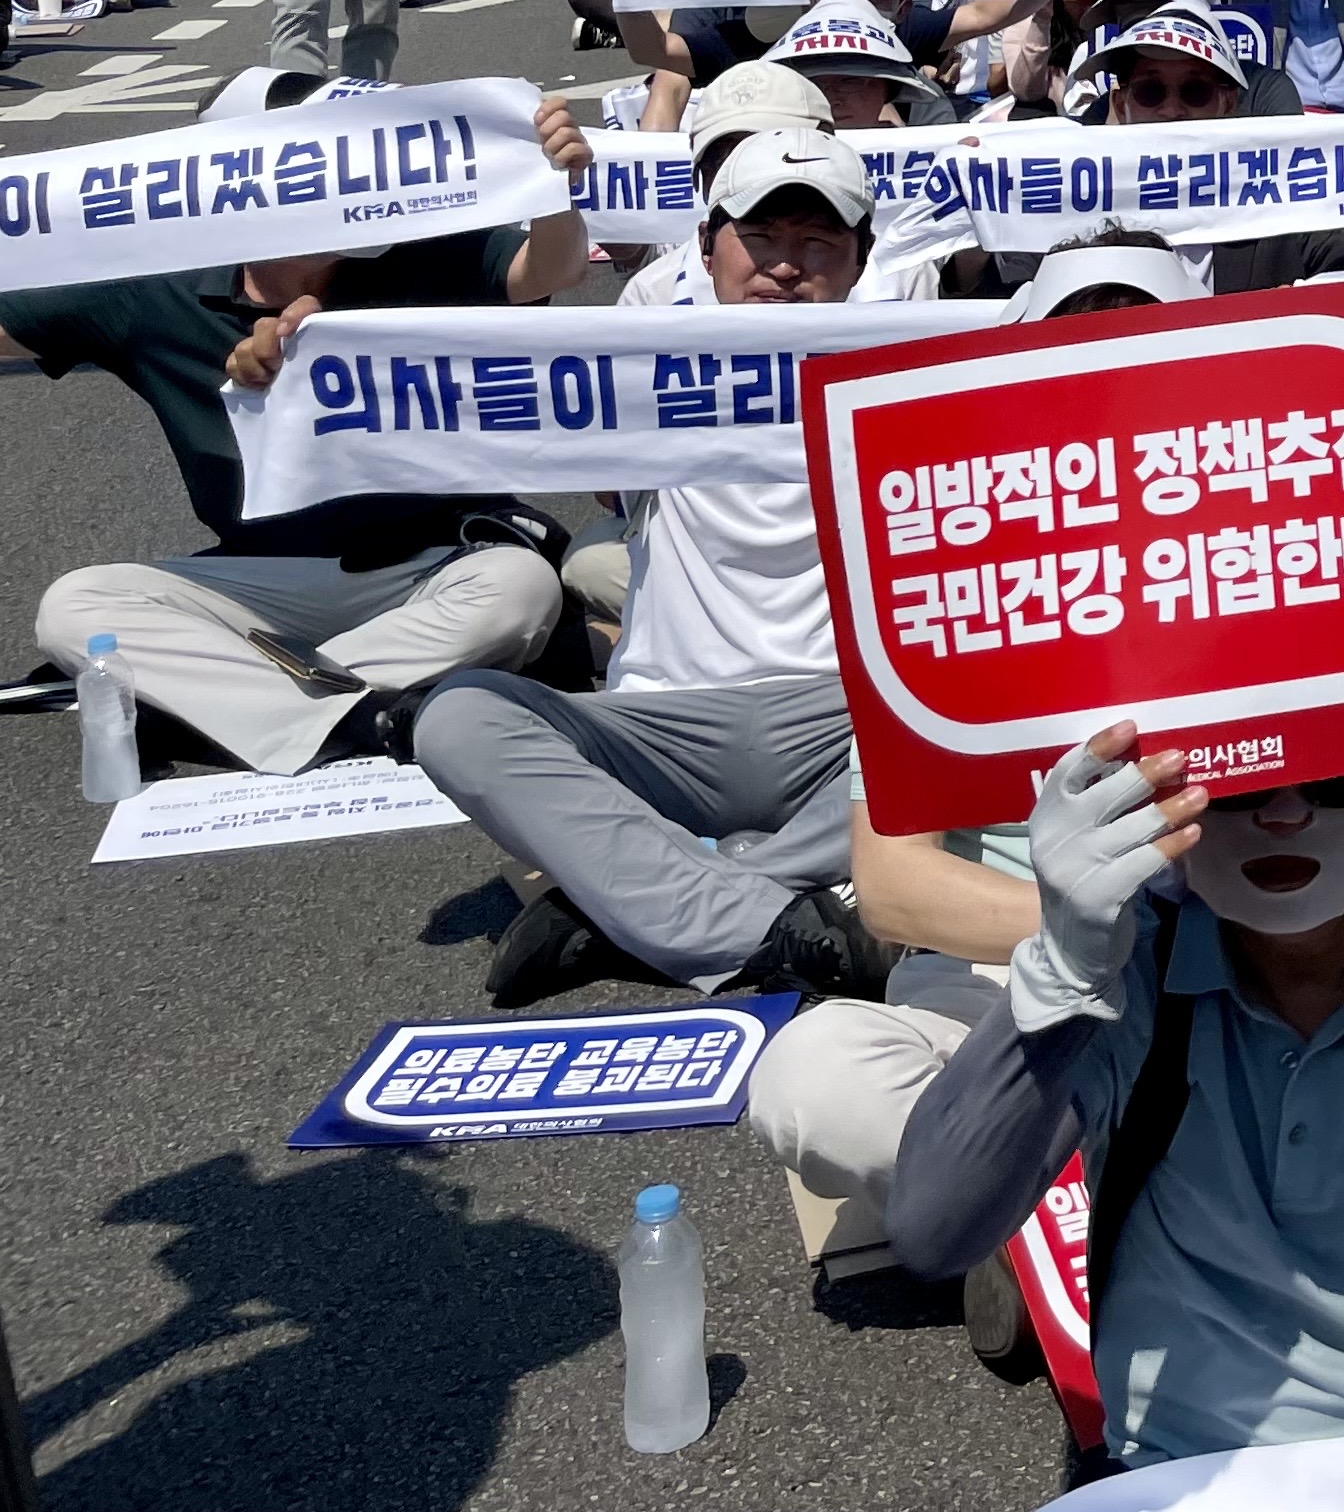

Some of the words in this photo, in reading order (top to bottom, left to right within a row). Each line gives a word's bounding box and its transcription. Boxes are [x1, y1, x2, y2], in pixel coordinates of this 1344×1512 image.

[794, 34, 869, 53] 저지
[1134, 31, 1213, 60] 저지
[79, 115, 477, 230] 살리겠습니다!
[571, 159, 695, 211] 의사들
[926, 154, 1114, 223] 의사들이
[343, 198, 404, 225] KMA
[406, 189, 478, 209] 대한의사협회
[310, 353, 617, 437] 의사들이
[880, 437, 1120, 557] 일방적인
[891, 545, 1128, 659] 국민건강
[1189, 734, 1284, 771] 의사협회
[1225, 759, 1285, 778] ASSOCIATION
[393, 1041, 568, 1078] 의료농단
[570, 1029, 737, 1068] 교육농단
[377, 1071, 549, 1108] 필수의료
[553, 1059, 722, 1097] 붕괴된다
[429, 1122, 508, 1138] KMA
